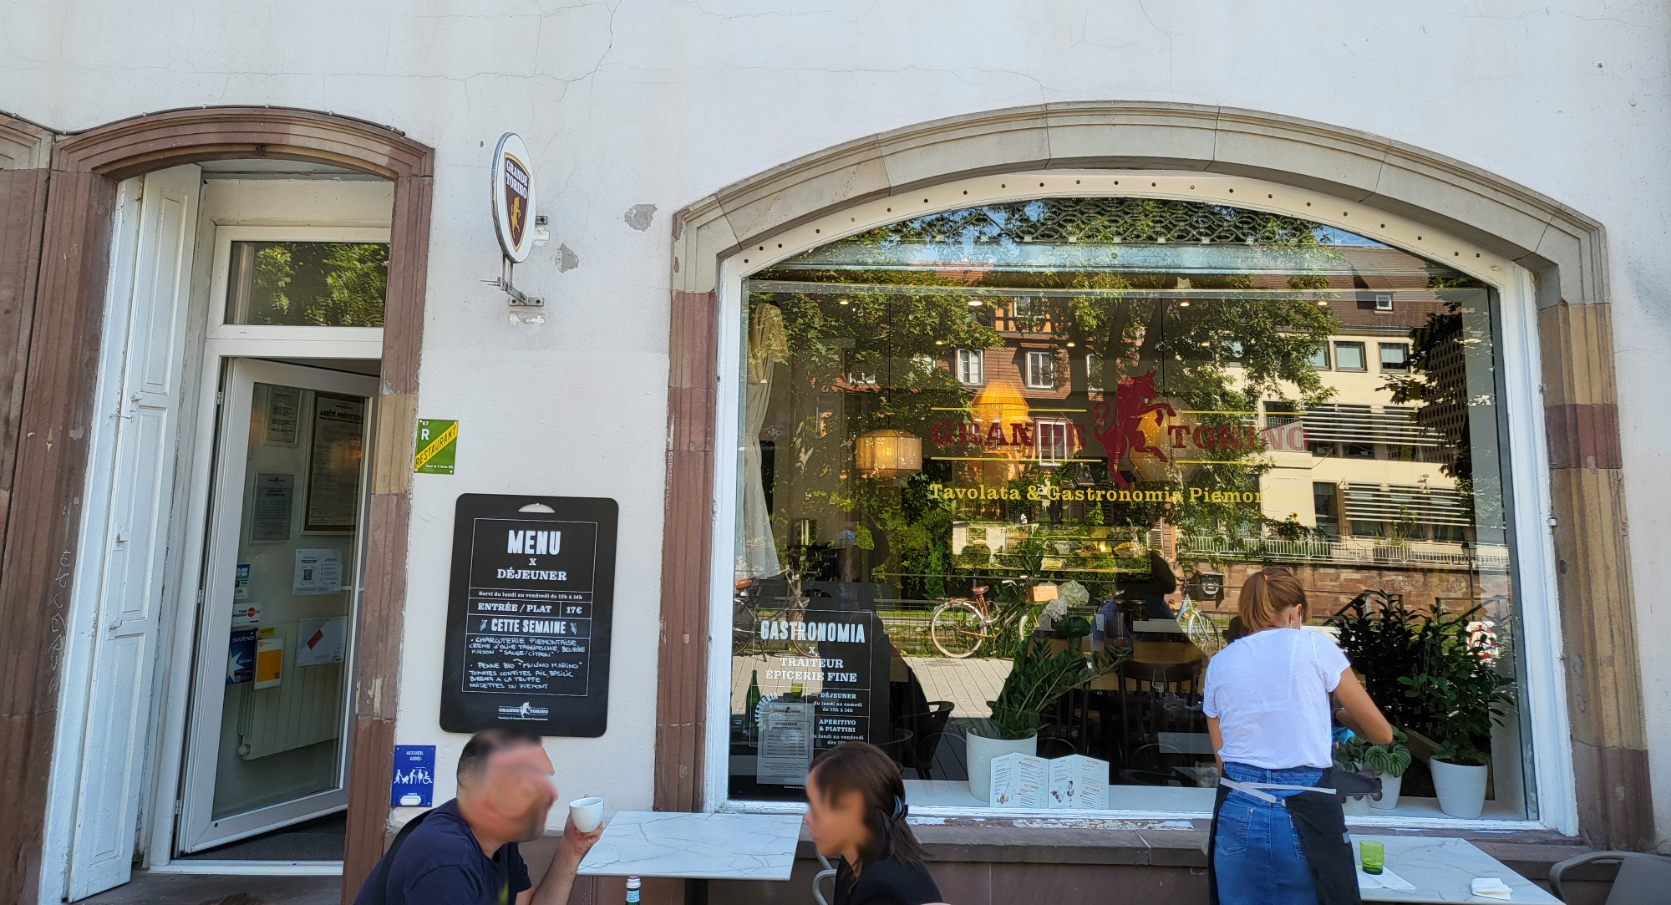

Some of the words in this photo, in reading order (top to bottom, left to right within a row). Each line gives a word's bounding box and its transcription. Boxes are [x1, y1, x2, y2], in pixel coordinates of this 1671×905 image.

[506, 160, 528, 187] GRANDE
[506, 172, 528, 199] TORINO
[421, 428, 430, 441] R
[931, 421, 1086, 447] GRANDE
[1168, 425, 1310, 451] TORINO
[415, 424, 457, 468] RESTAURANT
[929, 483, 1021, 501] Tavolata
[1027, 485, 1041, 501] &
[1046, 485, 1184, 502] Gastronomia
[507, 529, 561, 555] MENU
[497, 567, 567, 581] DÉJEUNER
[478, 602, 518, 612] ENTRÉE
[526, 605, 552, 613] PLAT
[566, 606, 583, 615] 17€
[491, 618, 520, 633] CETTE
[522, 620, 566, 634] SEMAINE
[760, 620, 866, 643] GASTRONOMIA
[780, 657, 844, 669] TRAITEUR
[765, 667, 825, 681] ÉPICERIE
[827, 672, 858, 683] FINE
